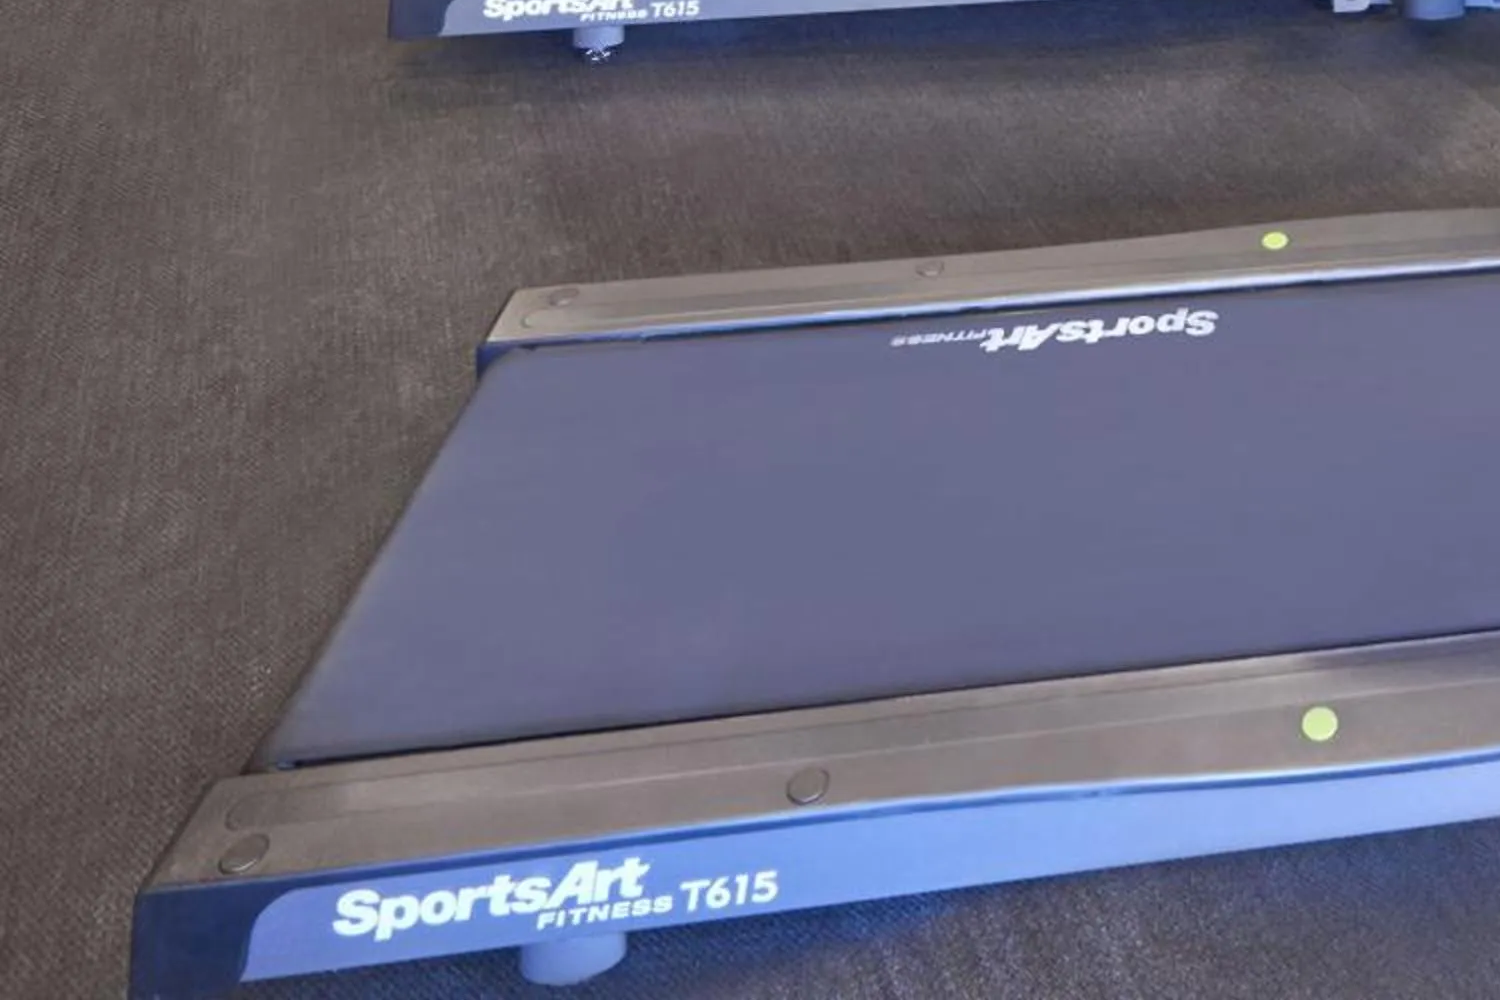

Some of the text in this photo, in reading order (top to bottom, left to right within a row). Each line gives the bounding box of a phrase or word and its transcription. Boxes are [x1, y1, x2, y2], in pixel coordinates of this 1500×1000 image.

[579, 8, 648, 22] FITNESS
[651, 0, 700, 18] T615
[889, 307, 1220, 353] SportsArt FITNESS
[332, 856, 673, 942] SportsArt FITNESS
[679, 869, 780, 913] T615
